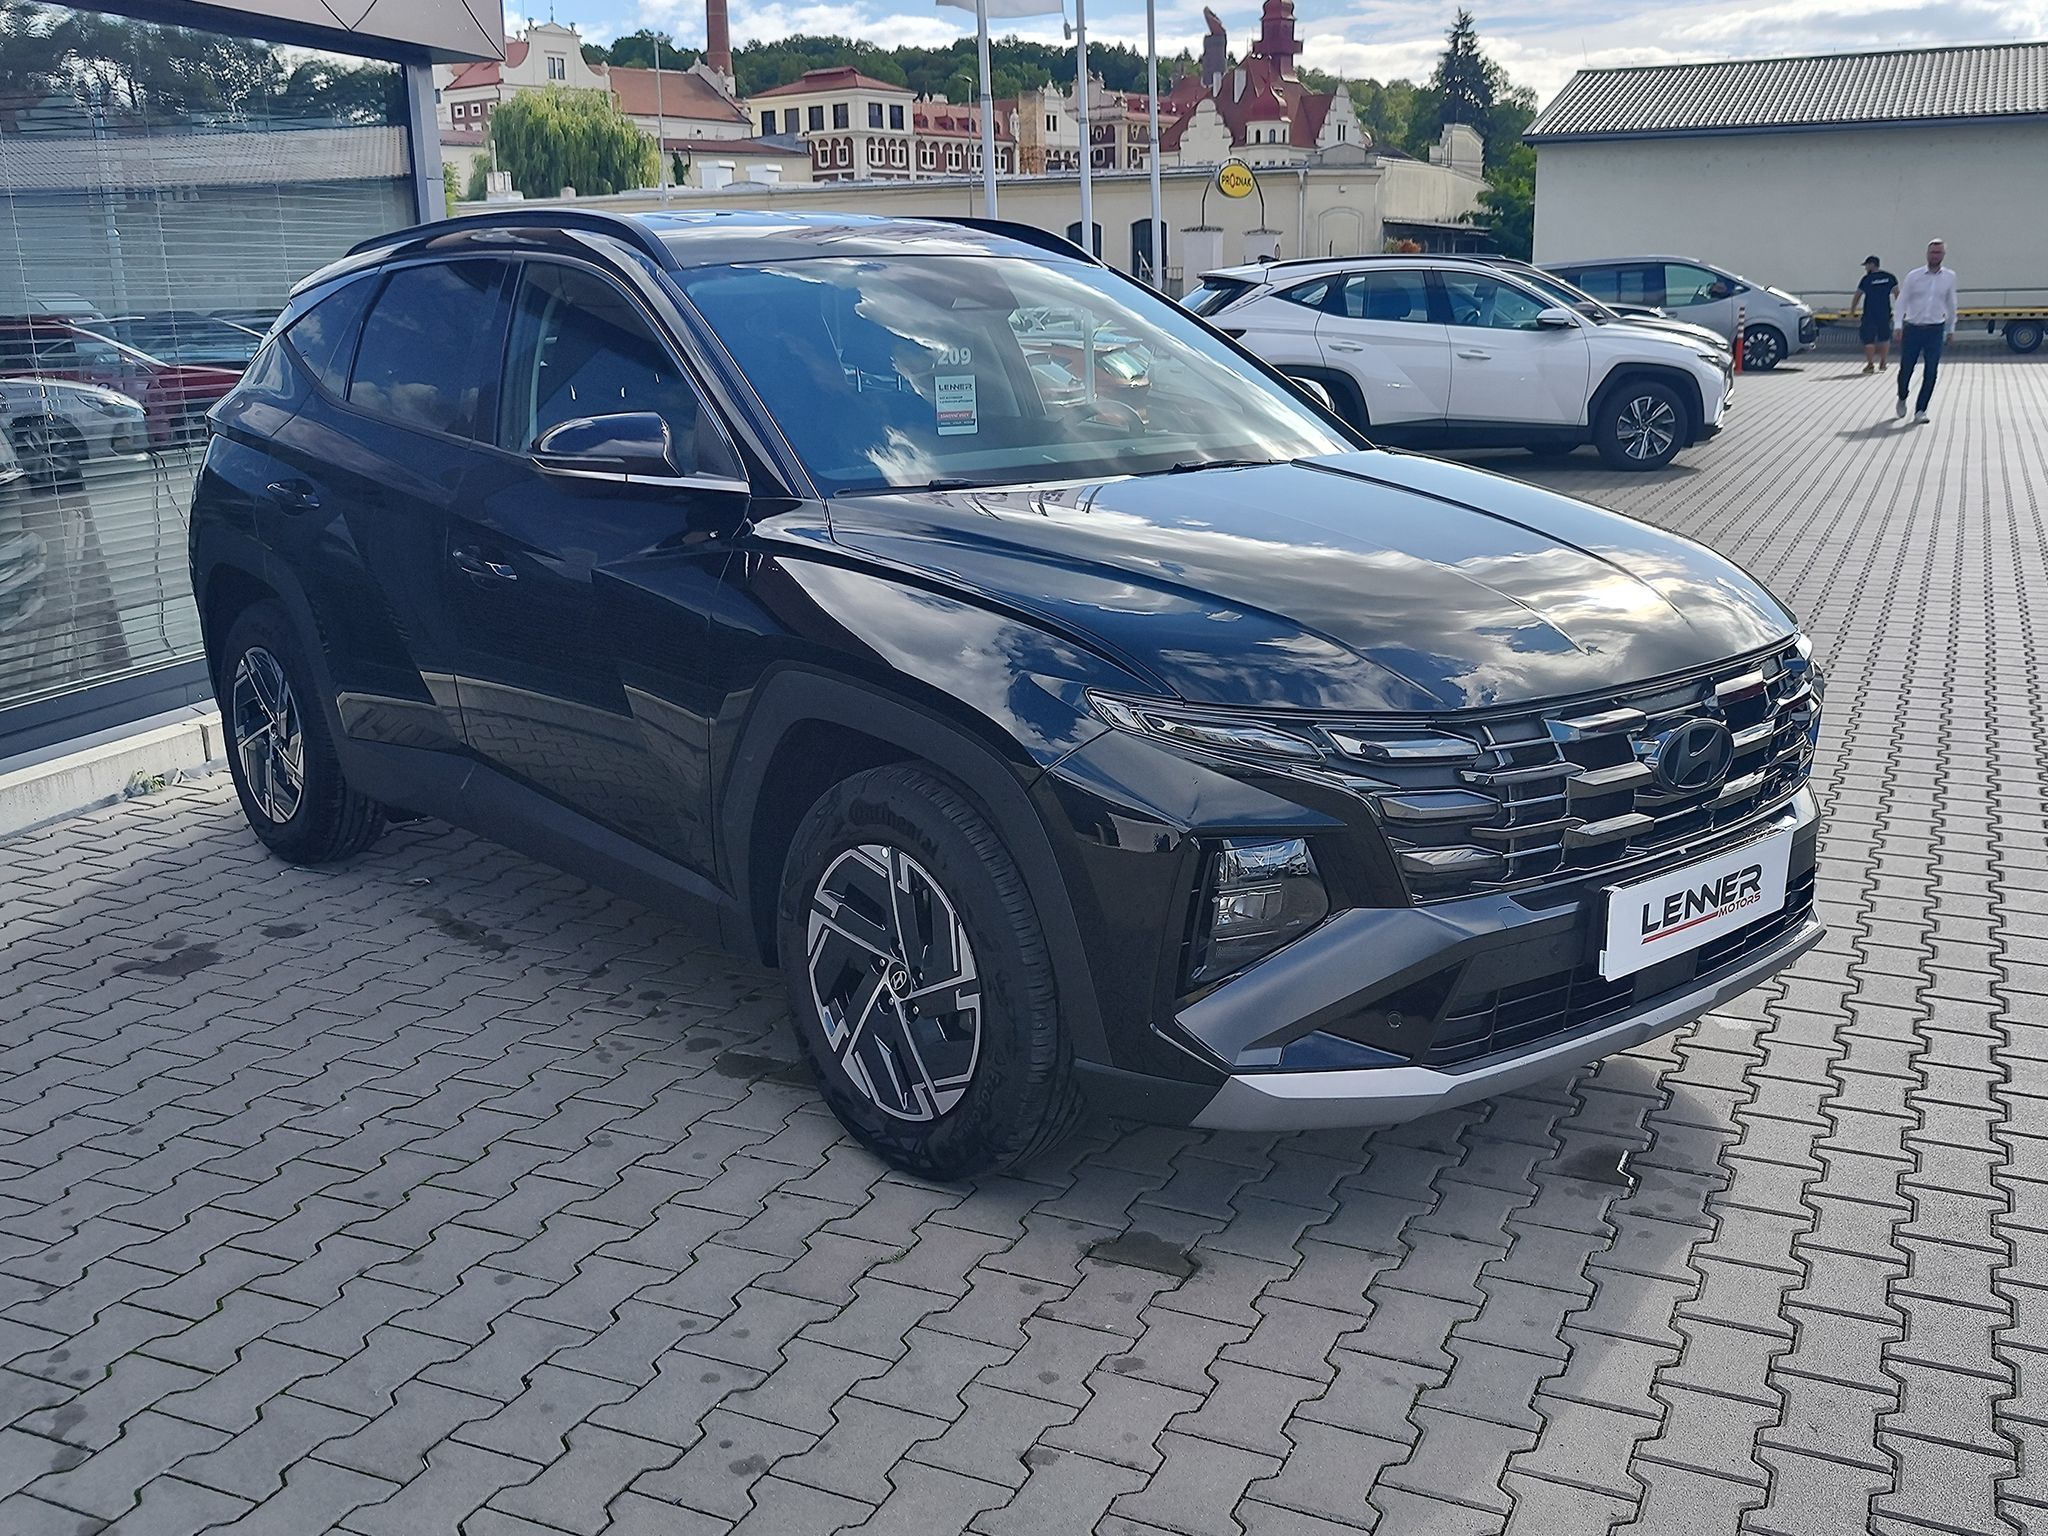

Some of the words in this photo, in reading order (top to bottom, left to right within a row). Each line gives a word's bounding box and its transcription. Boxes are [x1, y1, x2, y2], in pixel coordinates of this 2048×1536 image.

[937, 346, 972, 366] 209
[1641, 863, 1763, 935] LENNER
[1718, 892, 1761, 918] MOTORS
